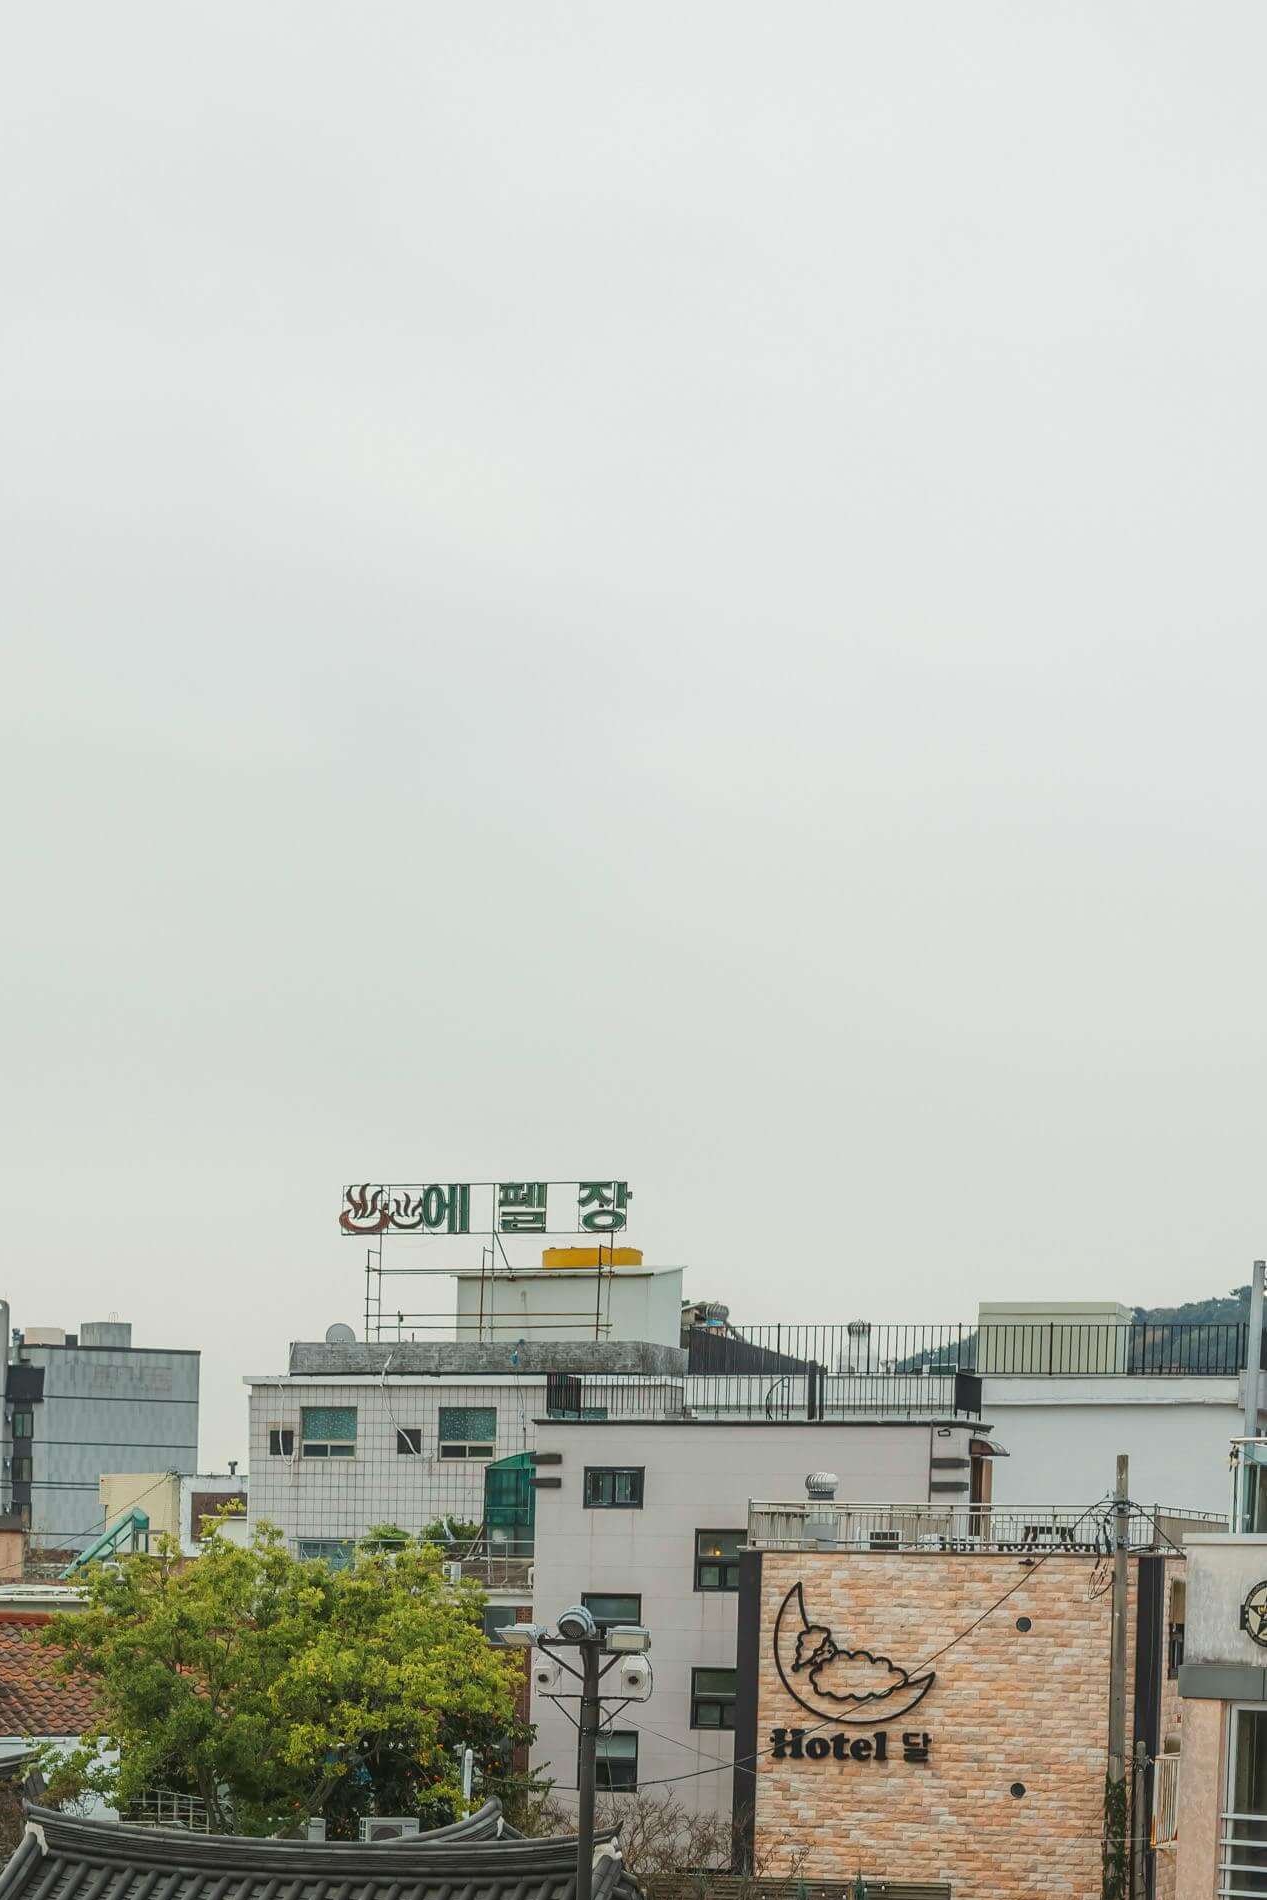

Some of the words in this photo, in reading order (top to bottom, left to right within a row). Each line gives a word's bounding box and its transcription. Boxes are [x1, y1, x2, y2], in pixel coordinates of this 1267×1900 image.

[422, 1182, 633, 1234] 에펠장
[770, 1728, 888, 1761] Hotel
[902, 1732, 933, 1763] 달
